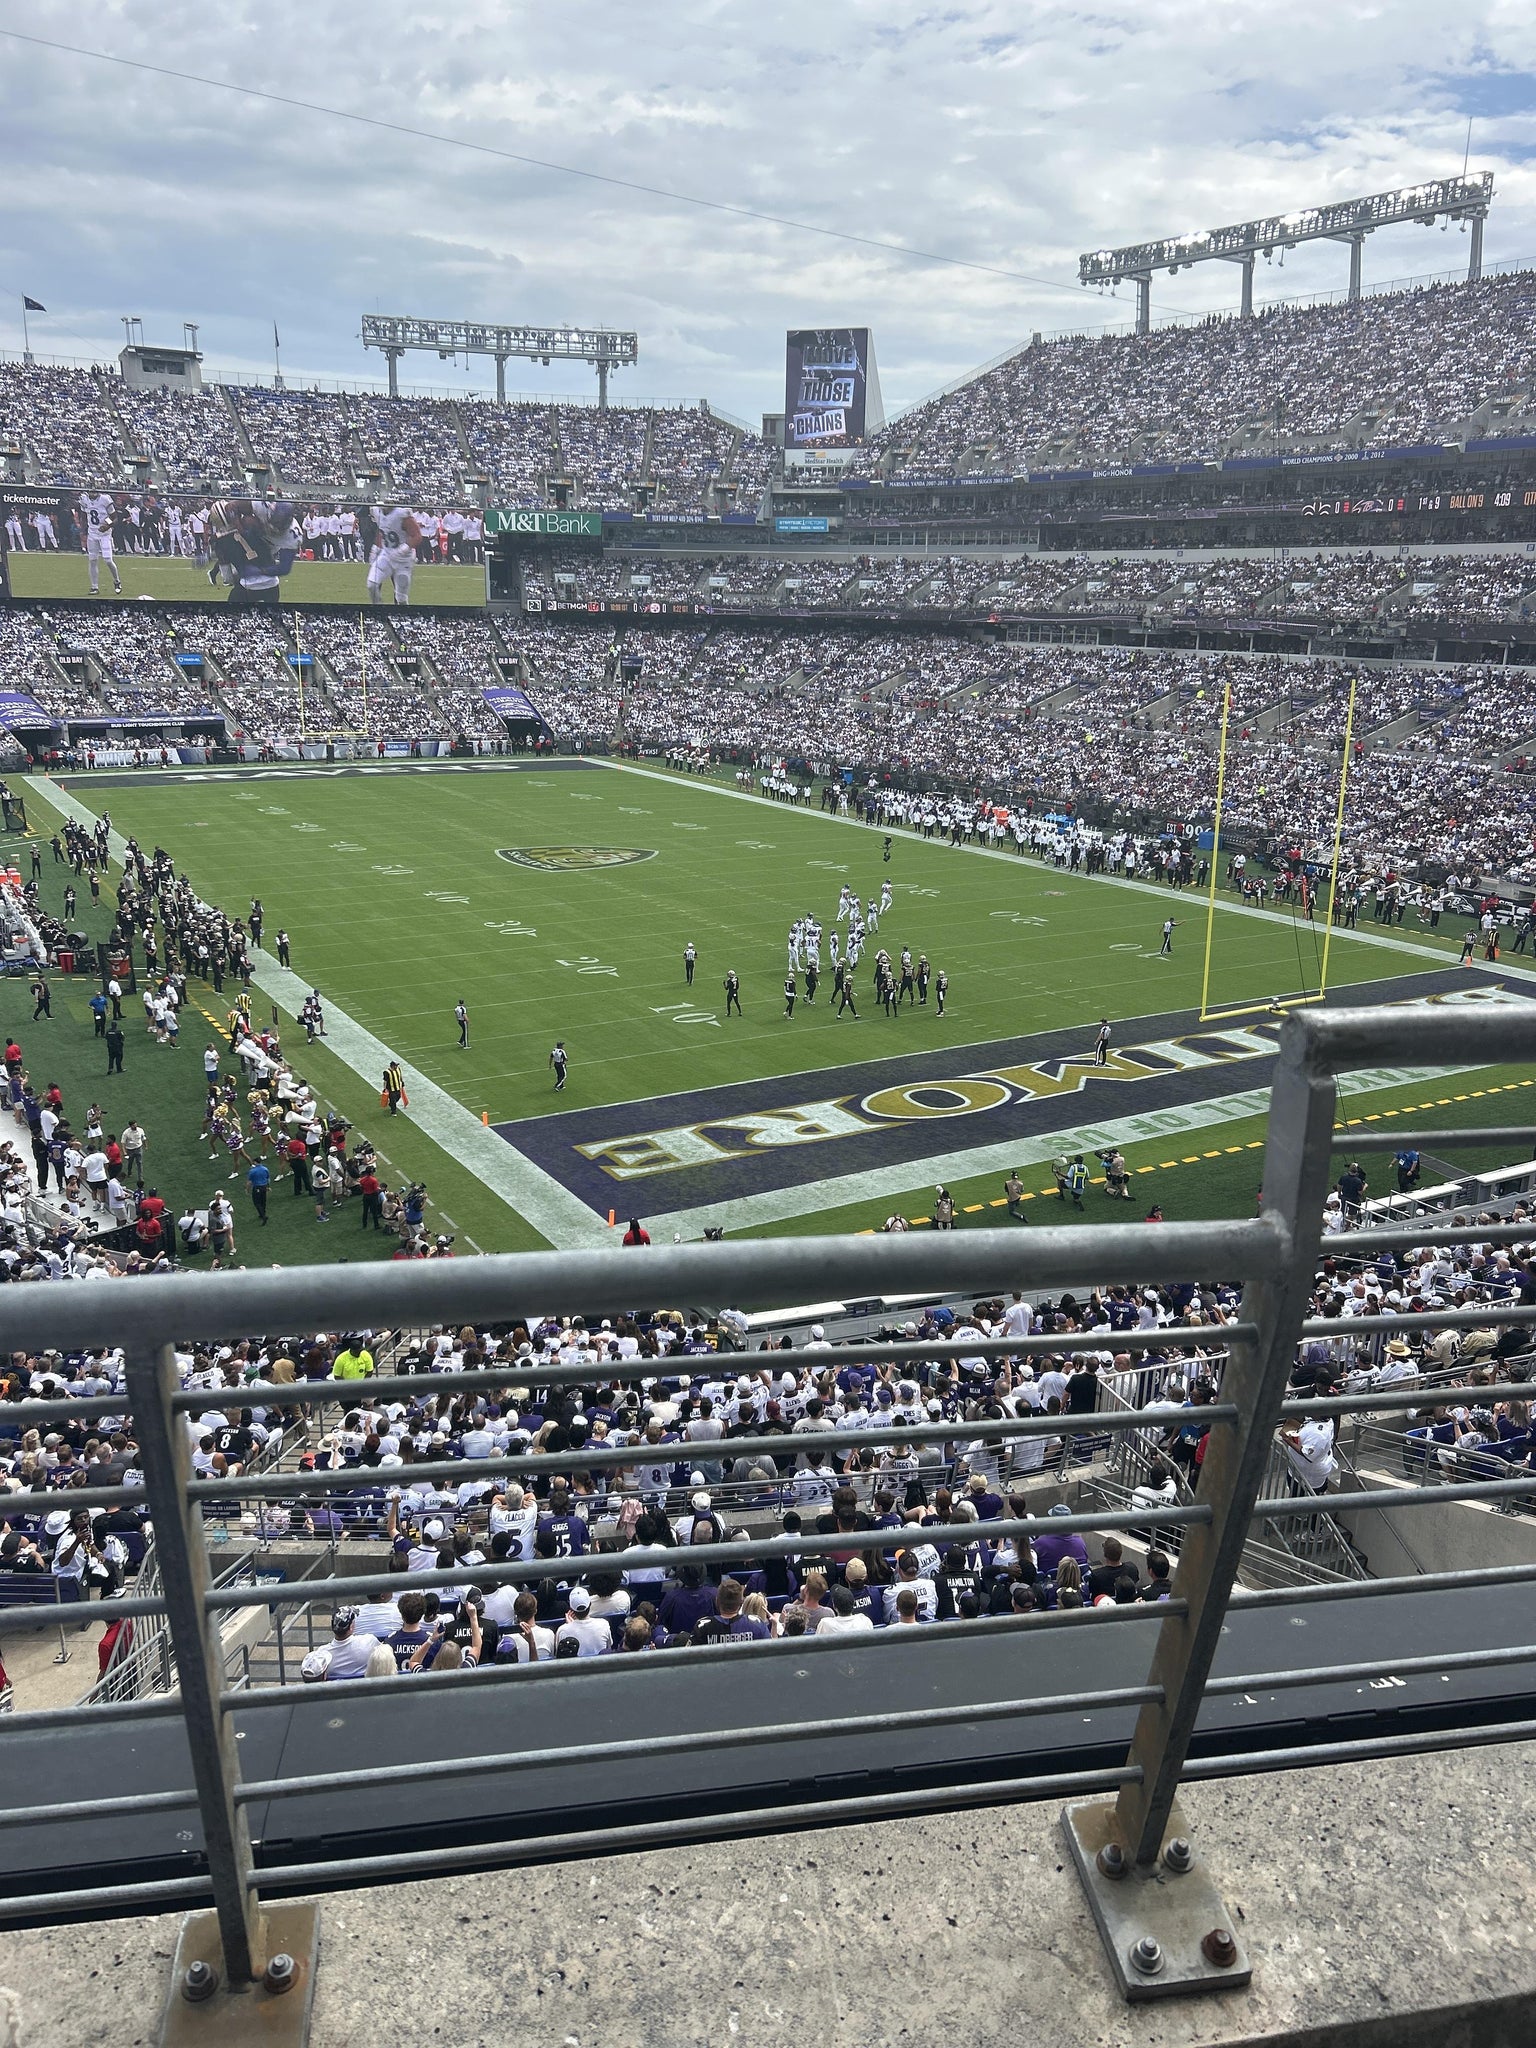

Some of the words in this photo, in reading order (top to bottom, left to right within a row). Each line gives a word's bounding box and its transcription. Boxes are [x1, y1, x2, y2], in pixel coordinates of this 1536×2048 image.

[803, 382, 850, 402] THOSE
[796, 412, 843, 434] CHAINS
[1302, 456, 1333, 464] CHAMPIONS
[1344, 453, 1358, 461] 2000
[1370, 451, 1385, 459] 2012
[1092, 470, 1107, 478] RING
[3, 493, 61, 506] ticketmaster
[1449, 496, 1466, 509] BALL
[1494, 492, 1511, 507] 4:09
[90, 509, 100, 526] 8
[497, 511, 545, 532] M&T
[546, 512, 591, 535] Bank
[557, 602, 588, 610] BETMGM
[59, 656, 70, 664] OLD
[71, 656, 84, 664] BAY
[396, 656, 406, 664] OLD
[406, 656, 418, 664] BAY
[499, 657, 507, 665] OLD
[507, 657, 519, 665] BAY
[1166, 824, 1177, 832] EST
[484, 919, 537, 934] 30
[555, 956, 618, 975] 20
[648, 1002, 716, 1023] 10
[1128, 1112, 1193, 1137] OF
[1041, 1128, 1119, 1153] US
[1116, 1312, 1123, 1325] 4
[536, 1389, 548, 1403] 14
[594, 1412, 612, 1422] JACKSON
[220, 1433, 232, 1449] 8
[651, 1469, 662, 1482] 8
[505, 1511, 526, 1522] FLACCO
[551, 1523, 569, 1533] SUGGS
[505, 1528, 523, 1558] 5
[801, 1565, 828, 1577] KAMARA
[947, 1577, 975, 1587] HAMILTON
[706, 1631, 754, 1646] WILDBERGER
